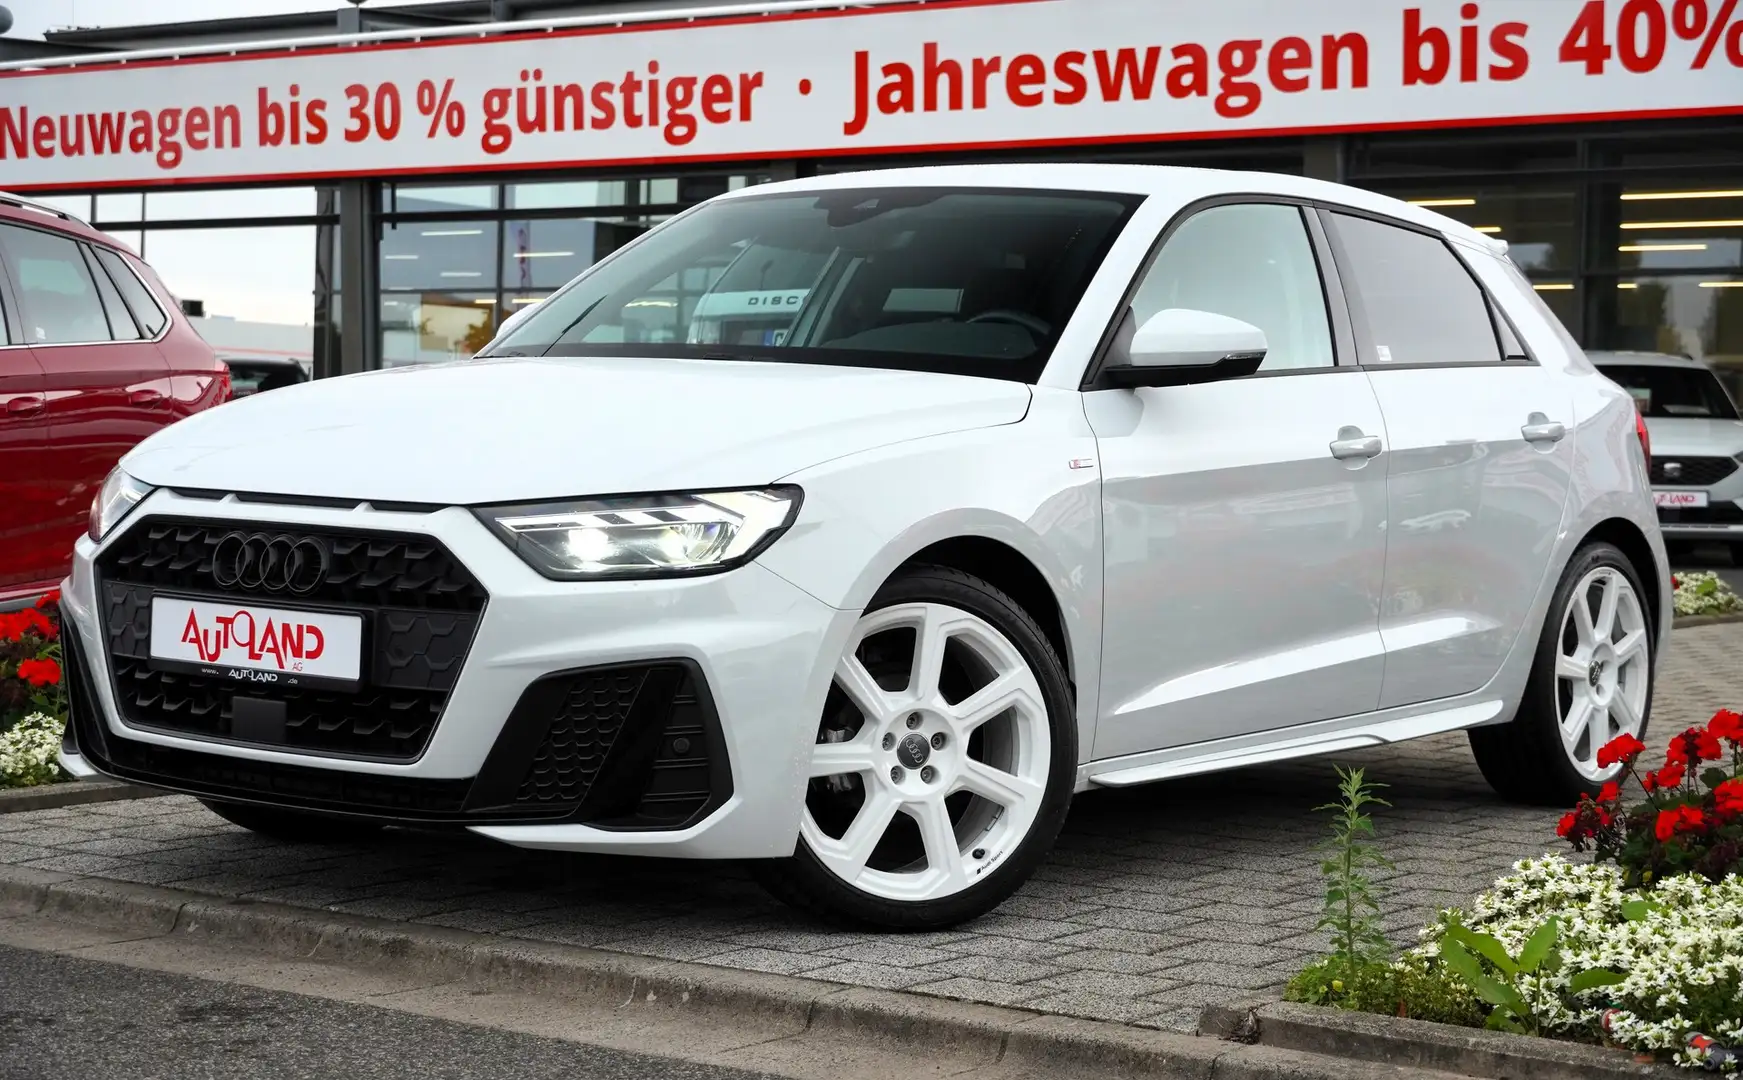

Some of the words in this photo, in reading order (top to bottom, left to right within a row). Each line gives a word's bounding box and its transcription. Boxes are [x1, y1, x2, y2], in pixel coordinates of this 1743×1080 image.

[0, 105, 241, 169] Neuwagen
[258, 84, 328, 146] bis
[343, 82, 402, 143] 30
[416, 78, 466, 139] %
[480, 68, 764, 155] günstiger
[843, 40, 1369, 137] Jahreswagen
[1402, 2, 1530, 87] bis
[1559, 0, 1743, 76] 40%
[747, 295, 799, 306] DISC
[181, 608, 325, 669] AUTOLAND
[292, 662, 303, 672] AG
[228, 669, 278, 682] AUTOLAND
